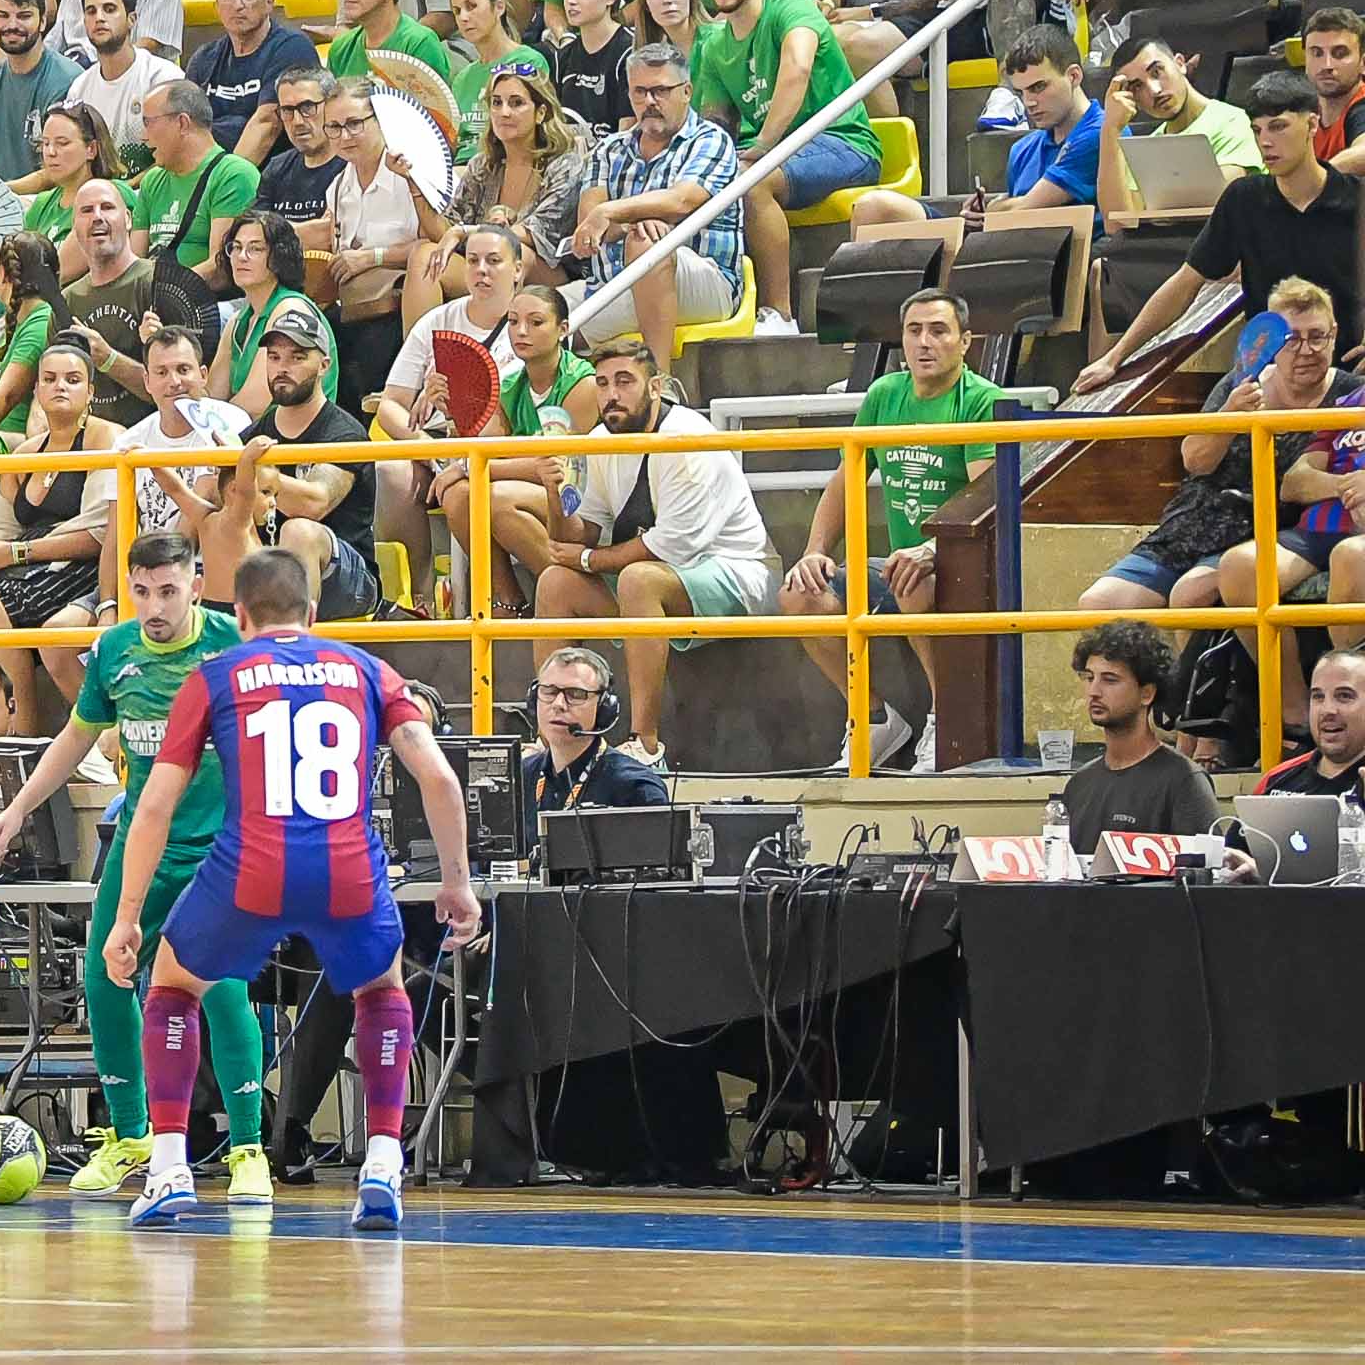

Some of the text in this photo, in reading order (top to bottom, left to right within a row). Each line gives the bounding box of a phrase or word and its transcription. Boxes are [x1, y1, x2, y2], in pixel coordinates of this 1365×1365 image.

[206, 78, 261, 101] HEAD
[83, 303, 138, 331] THENTIC
[886, 449, 943, 468] CATALUNYA
[236, 661, 359, 694] HARRISON
[245, 699, 362, 822] 18
[165, 1015, 186, 1051] BARÇA
[380, 1028, 399, 1066] BARÇA
